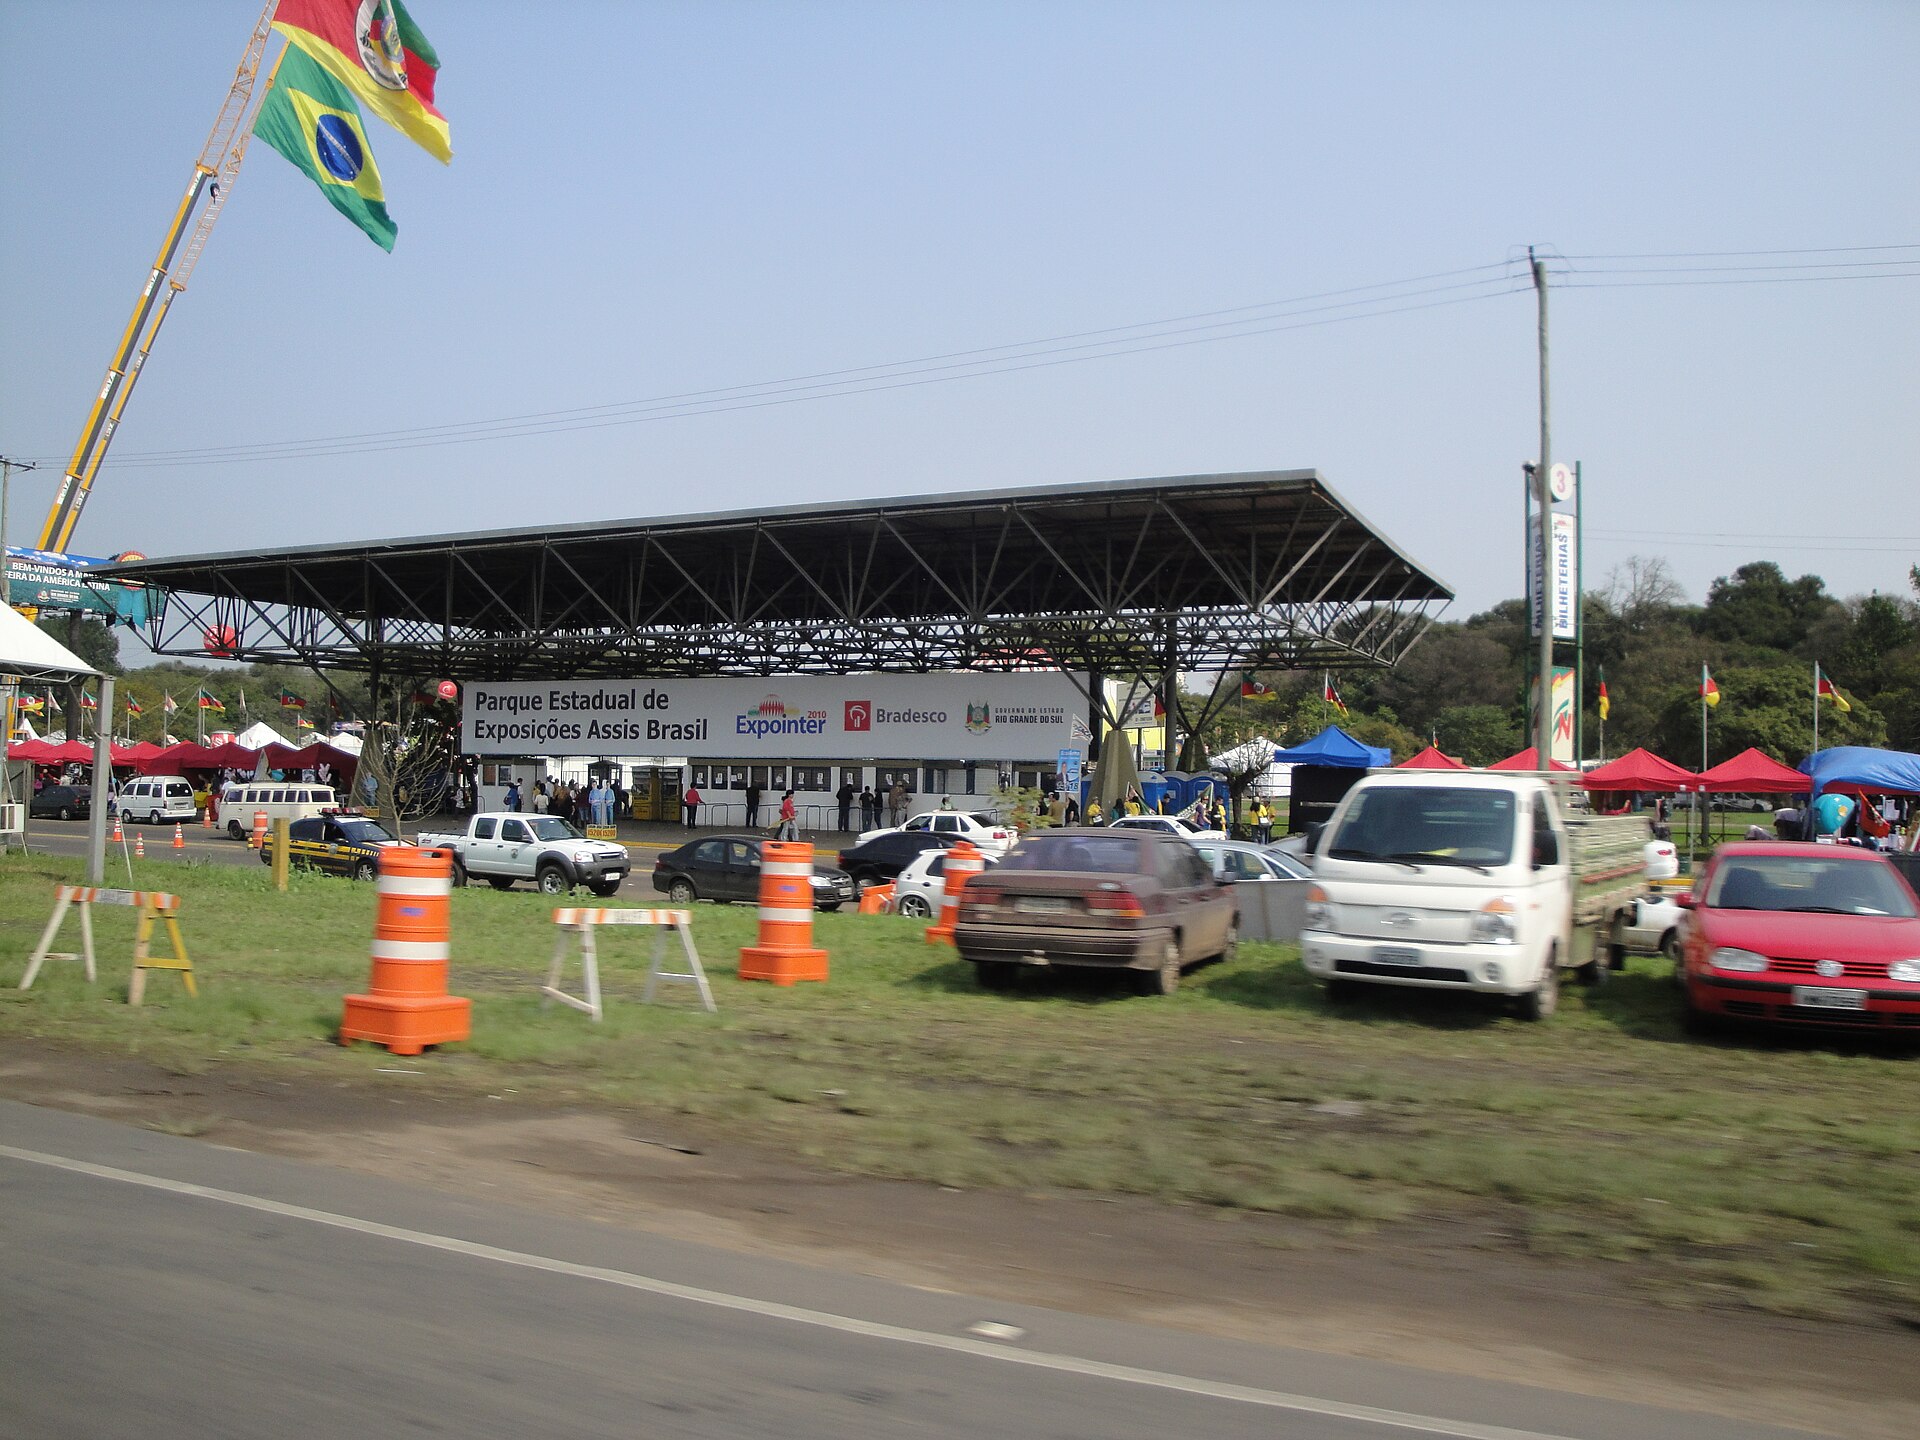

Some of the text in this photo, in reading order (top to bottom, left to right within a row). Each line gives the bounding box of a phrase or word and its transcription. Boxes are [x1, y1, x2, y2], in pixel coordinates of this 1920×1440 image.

[1556, 470, 1566, 493] 3
[12, 562, 67, 577] BEM-VINDOS
[67, 569, 74, 577] A
[29, 574, 42, 583] DA
[43, 575, 81, 588] AMÉRICA
[1558, 533, 1568, 629] BILHETERIAS
[475, 689, 669, 715] Parque Estadual de
[807, 710, 827, 719] 2010
[876, 708, 947, 724] Bradesco
[995, 715, 1064, 723] RIO GRANDE DO SUL
[474, 718, 708, 744] Exposições Assis Brasil
[736, 713, 826, 739] Expointer
